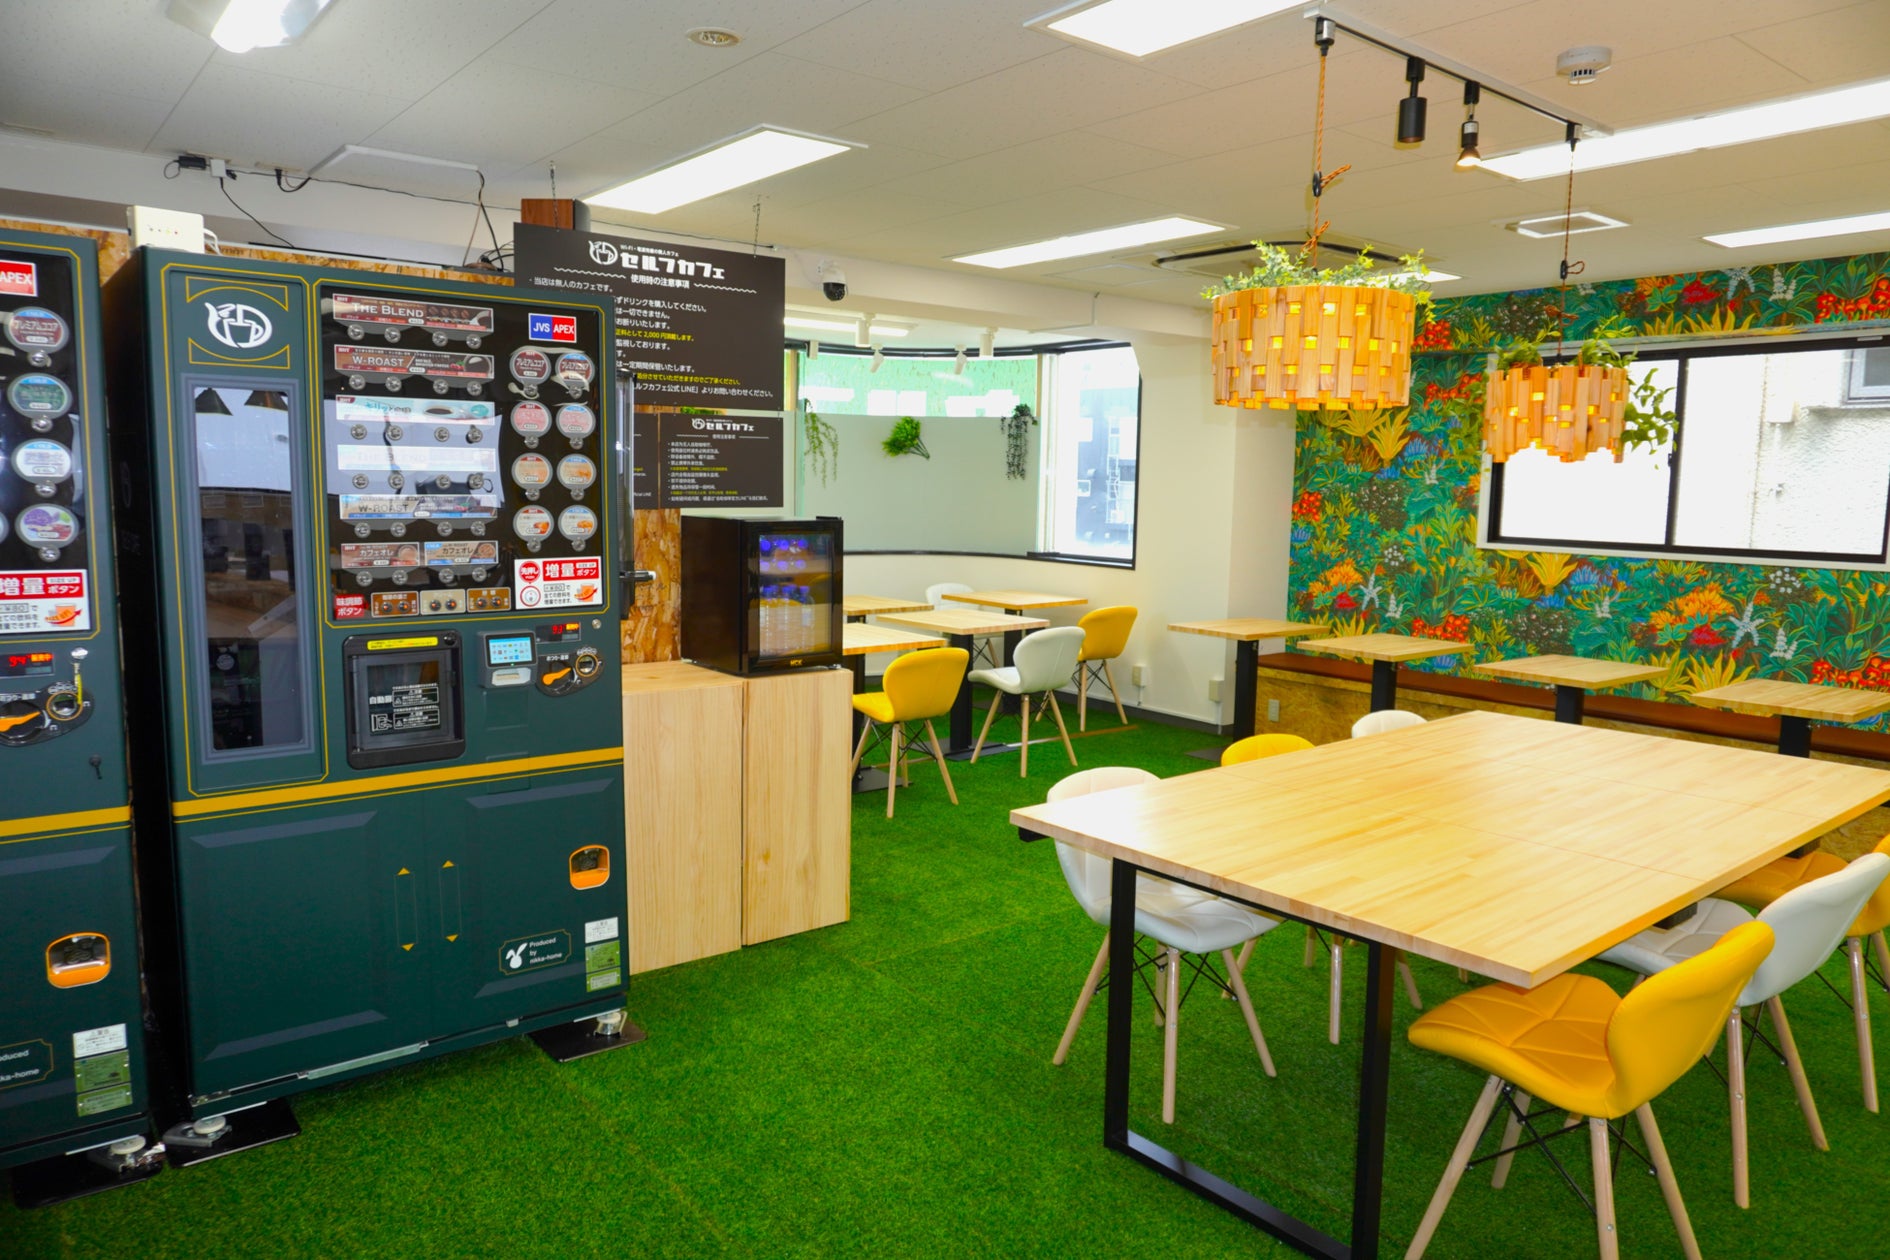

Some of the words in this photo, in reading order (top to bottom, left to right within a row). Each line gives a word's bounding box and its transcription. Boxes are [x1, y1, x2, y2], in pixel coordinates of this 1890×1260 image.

[620, 252, 725, 280] セルフカフェ
[631, 274, 690, 289] 使用時の注意事項
[352, 303, 378, 314] THE
[381, 305, 424, 318] BLEND
[533, 322, 550, 333] JVS
[553, 324, 575, 335] APEX
[352, 355, 404, 367] W-ROAST
[545, 562, 576, 579] 増量
[529, 937, 557, 948] Produced
[529, 949, 537, 957] by
